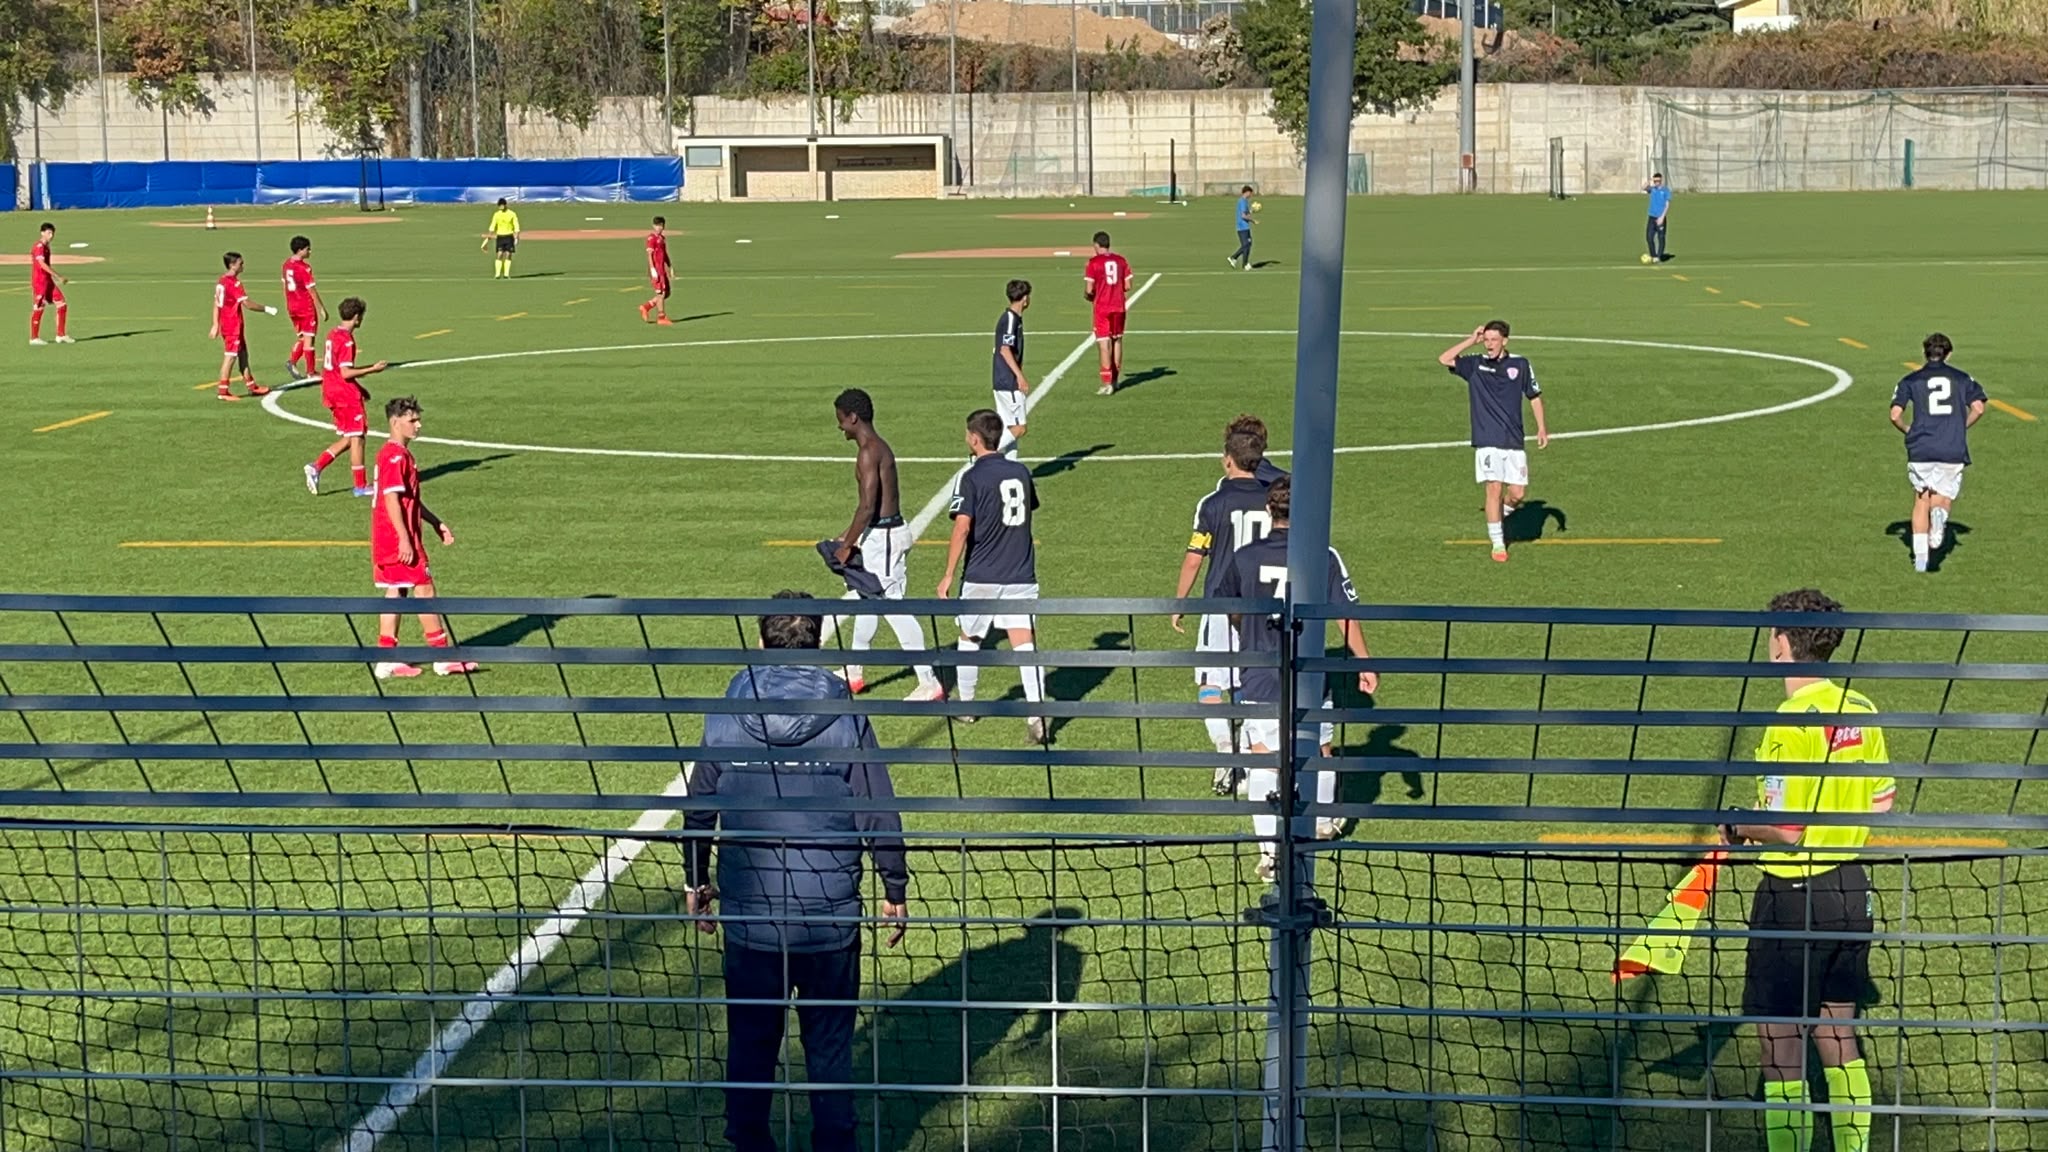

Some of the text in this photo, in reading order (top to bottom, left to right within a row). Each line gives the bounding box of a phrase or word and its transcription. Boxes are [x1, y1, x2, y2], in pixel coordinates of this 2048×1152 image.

[286, 269, 297, 292] 5
[1104, 261, 1118, 285] 9
[1927, 376, 1953, 415] 2
[1484, 454, 1491, 469] 4
[1000, 478, 1026, 526] 8
[1230, 510, 1273, 553] 10
